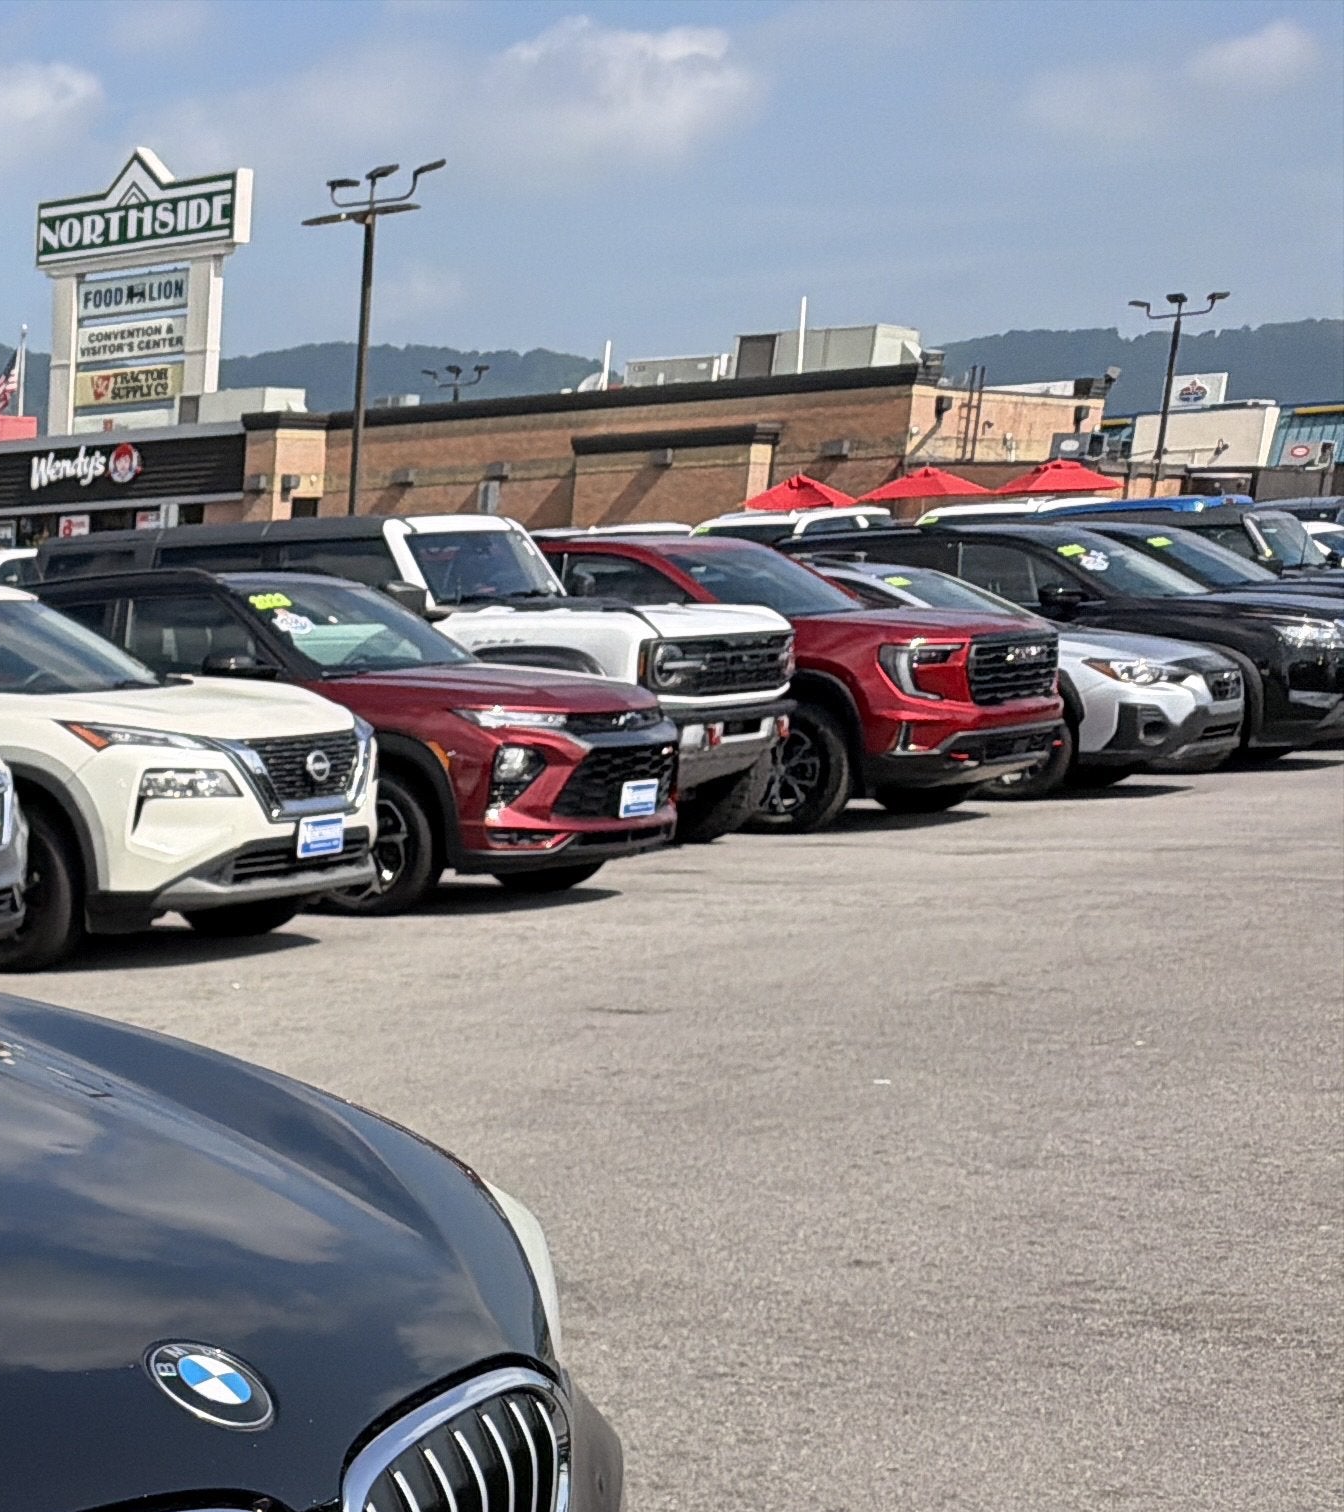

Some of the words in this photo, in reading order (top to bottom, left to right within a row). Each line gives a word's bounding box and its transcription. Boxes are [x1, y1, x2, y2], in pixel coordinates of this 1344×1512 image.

[39, 194, 231, 252] NORTHSIDE
[83, 286, 124, 309] FOOD
[148, 279, 184, 302] LION
[88, 323, 162, 343] CONVENTION
[166, 323, 175, 335] &
[80, 341, 134, 357] VISITOR'S
[137, 335, 184, 351] CENTER
[112, 368, 168, 385] TRACTOR
[111, 384, 152, 400] SUPPLY
[30, 445, 106, 490] Wendy's
